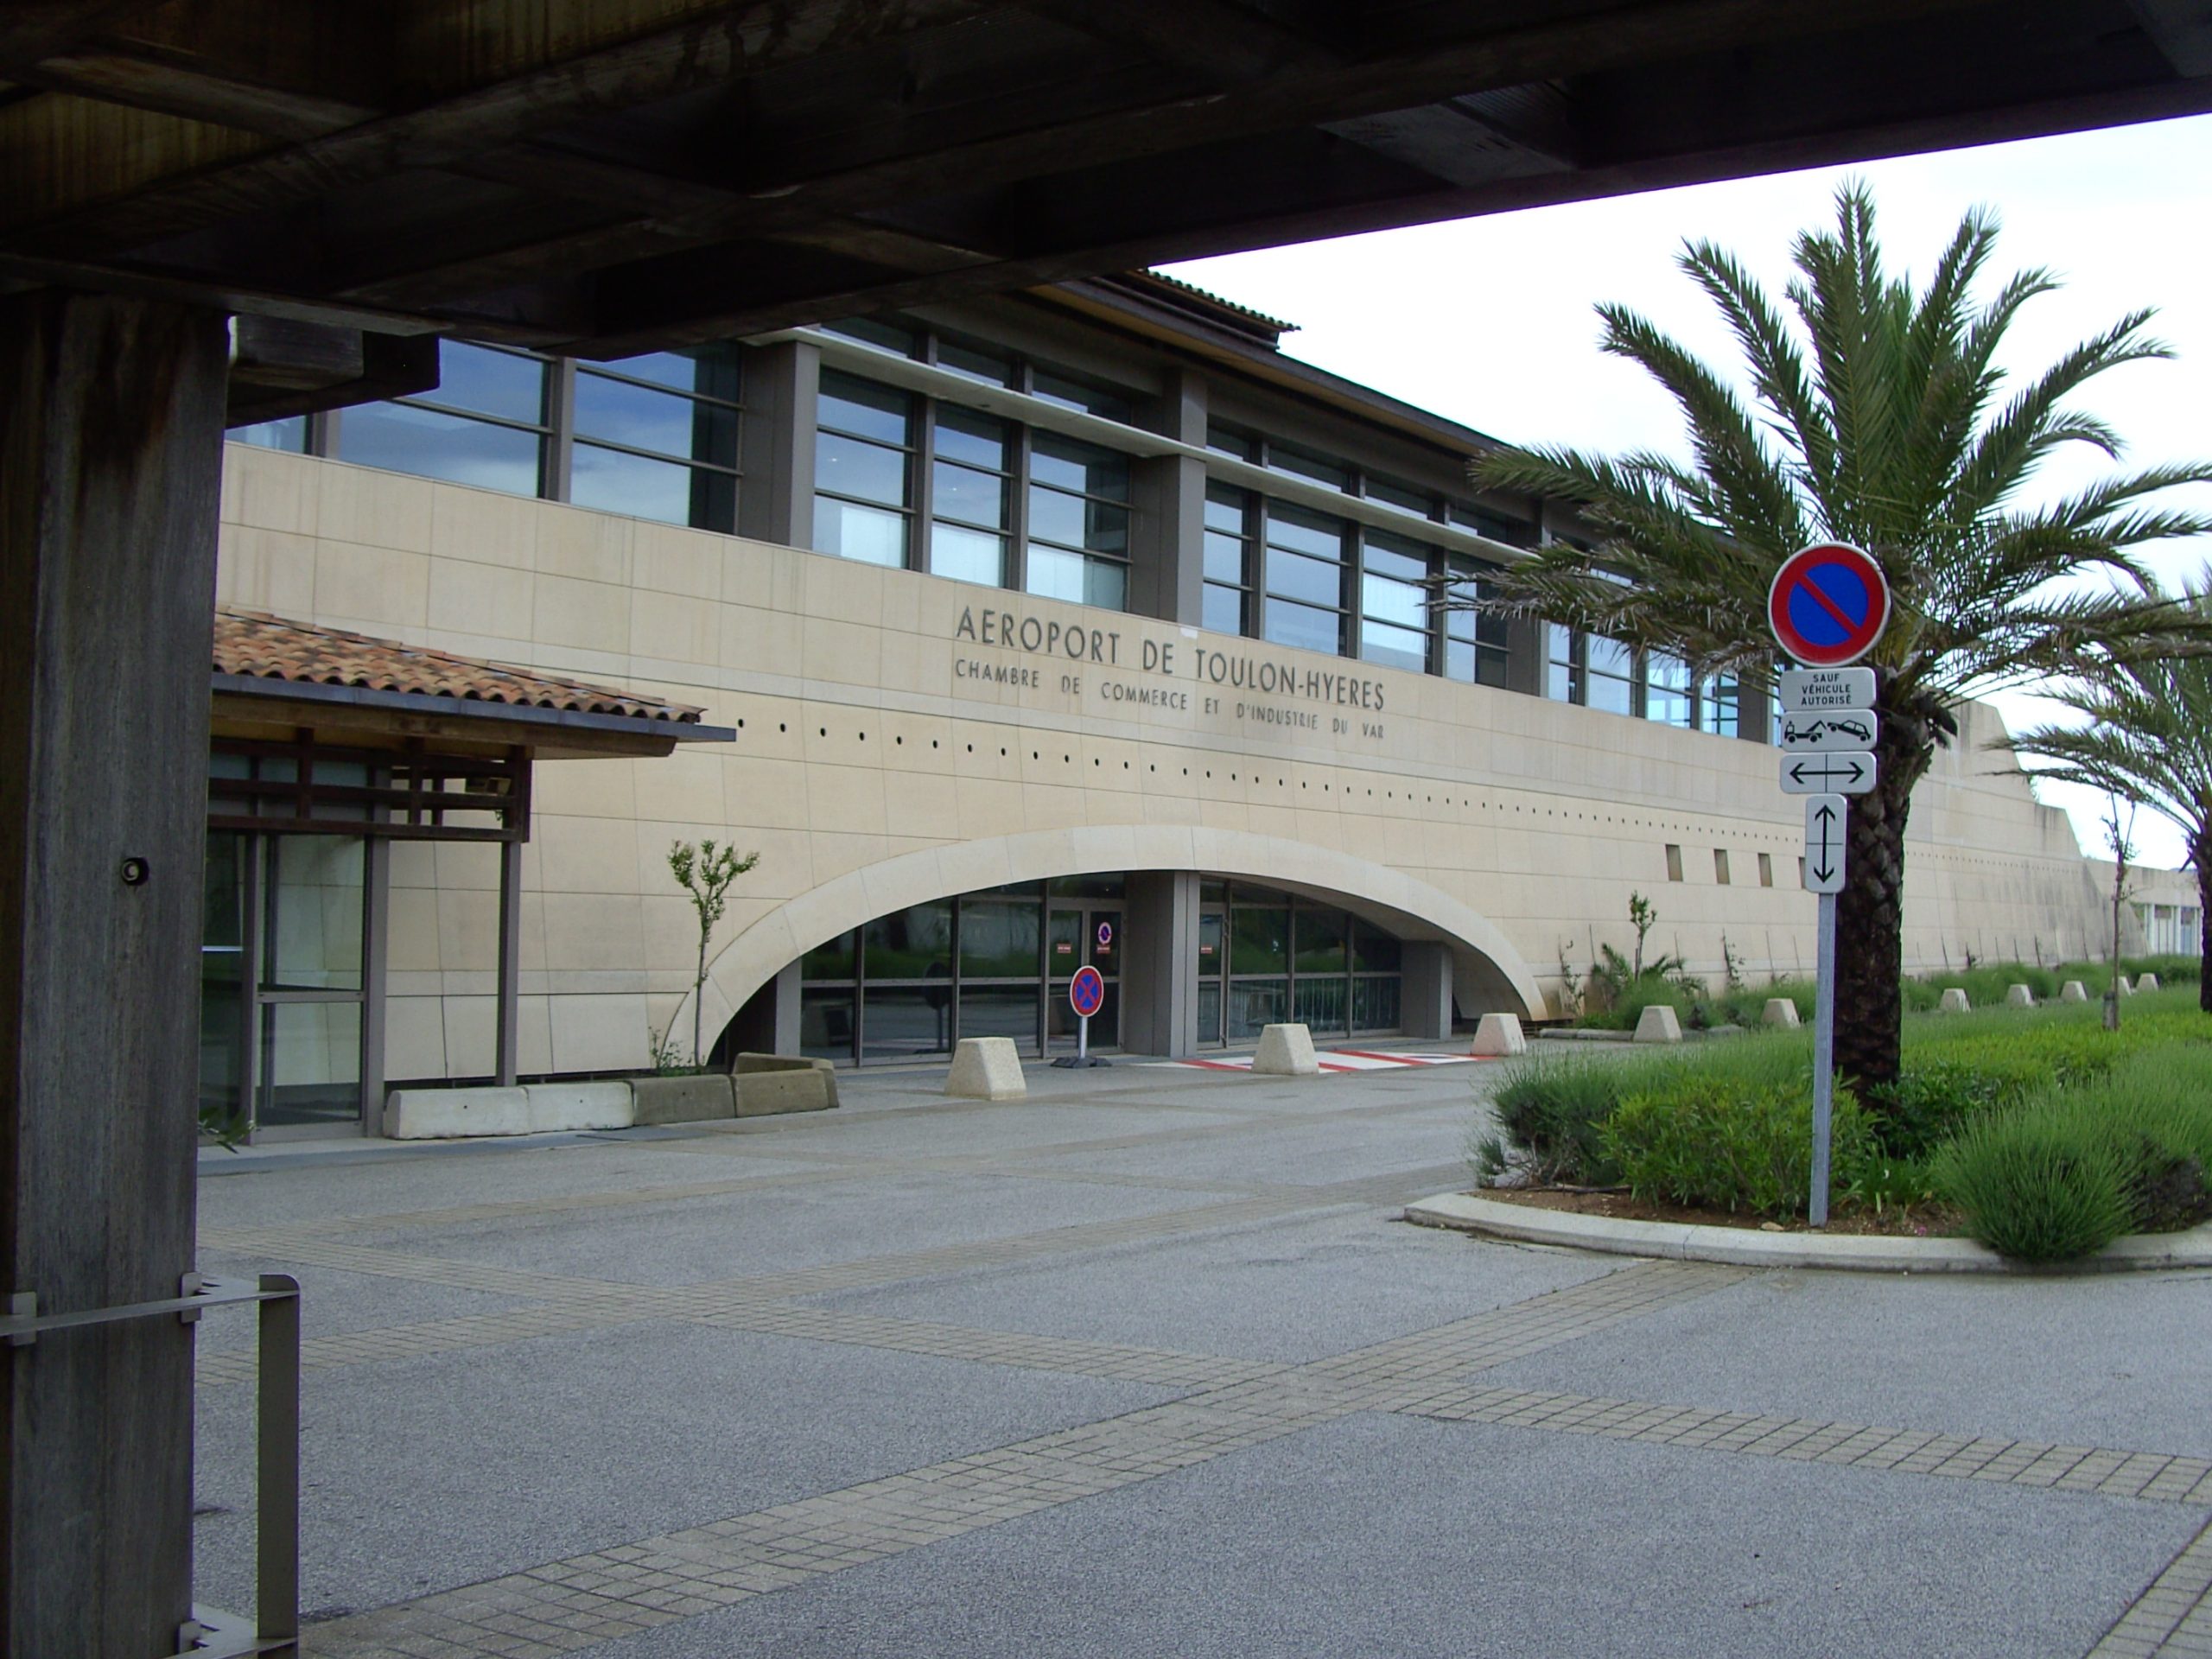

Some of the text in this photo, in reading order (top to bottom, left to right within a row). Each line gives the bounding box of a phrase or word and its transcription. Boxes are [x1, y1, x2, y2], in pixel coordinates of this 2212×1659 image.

[957, 606, 1384, 711] AEROPORT DE TOULON-HYERES
[1813, 673, 1840, 683] SAUF
[1802, 683, 1851, 694] VÉHICULE
[956, 659, 1384, 739] CHAMBRE DE COMMERCE ET D'INDUSTRIE DU VAR
[1801, 694, 1852, 705] AUTORISÉ
